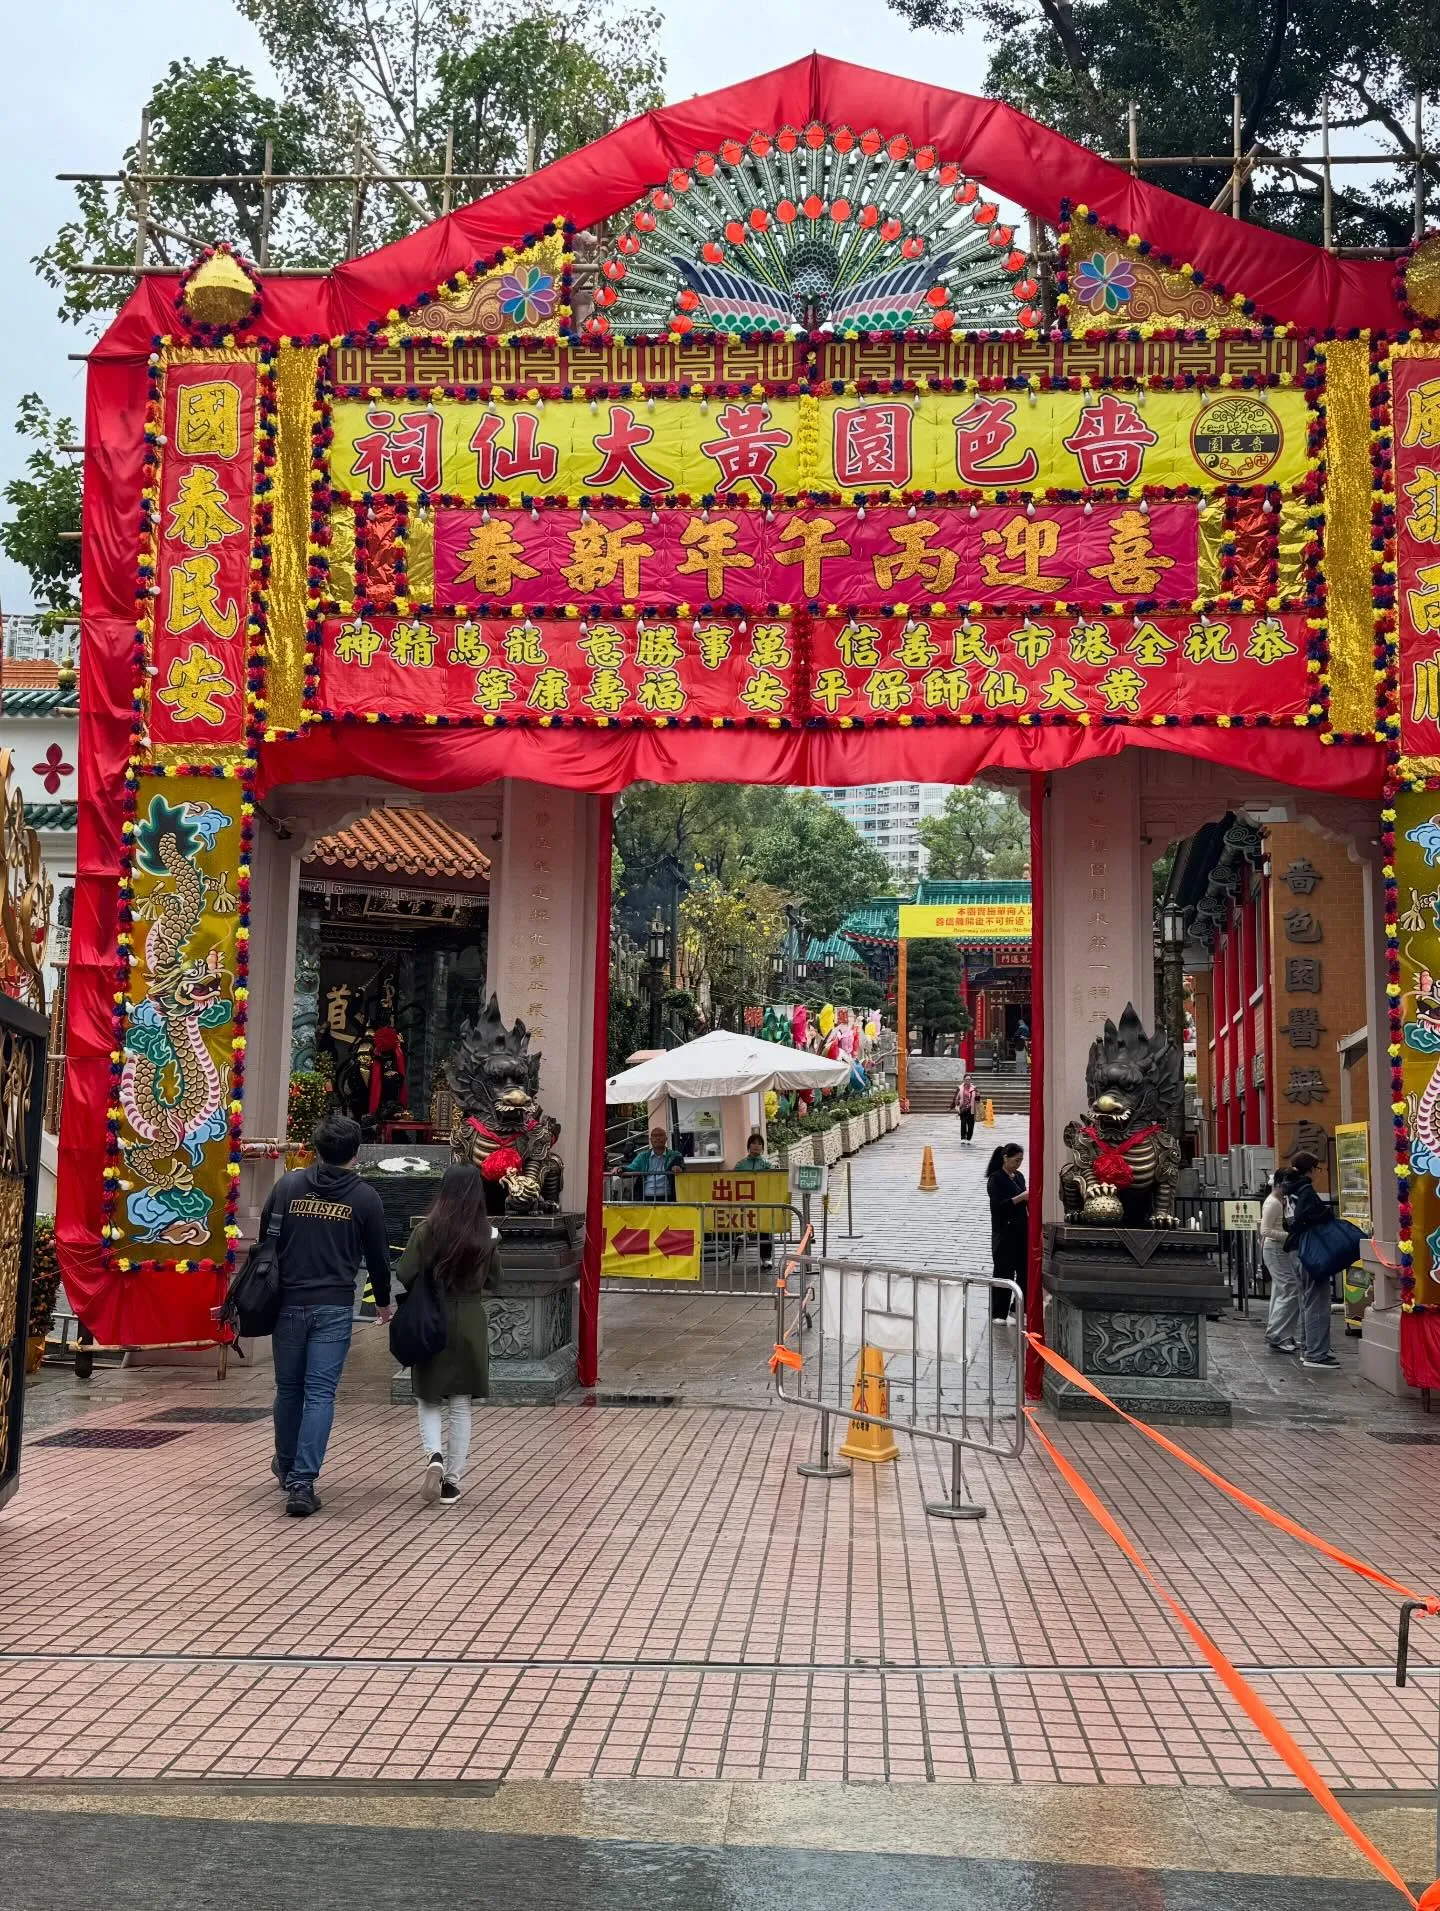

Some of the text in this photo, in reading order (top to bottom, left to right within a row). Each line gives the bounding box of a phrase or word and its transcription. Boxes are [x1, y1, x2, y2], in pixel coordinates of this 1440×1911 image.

[350, 396, 1158, 494] 嗇色園黃大仙祠
[157, 381, 244, 726] 國泰民安
[453, 511, 1176, 599] 喜迎丙午年新春
[836, 622, 1298, 668] 恭祝全港市民善信
[711, 1178, 756, 1201] 出口
[800, 1167, 818, 1178] 出口
[290, 1200, 352, 1218] HOLLISTER
[713, 1209, 757, 1229] Exit
